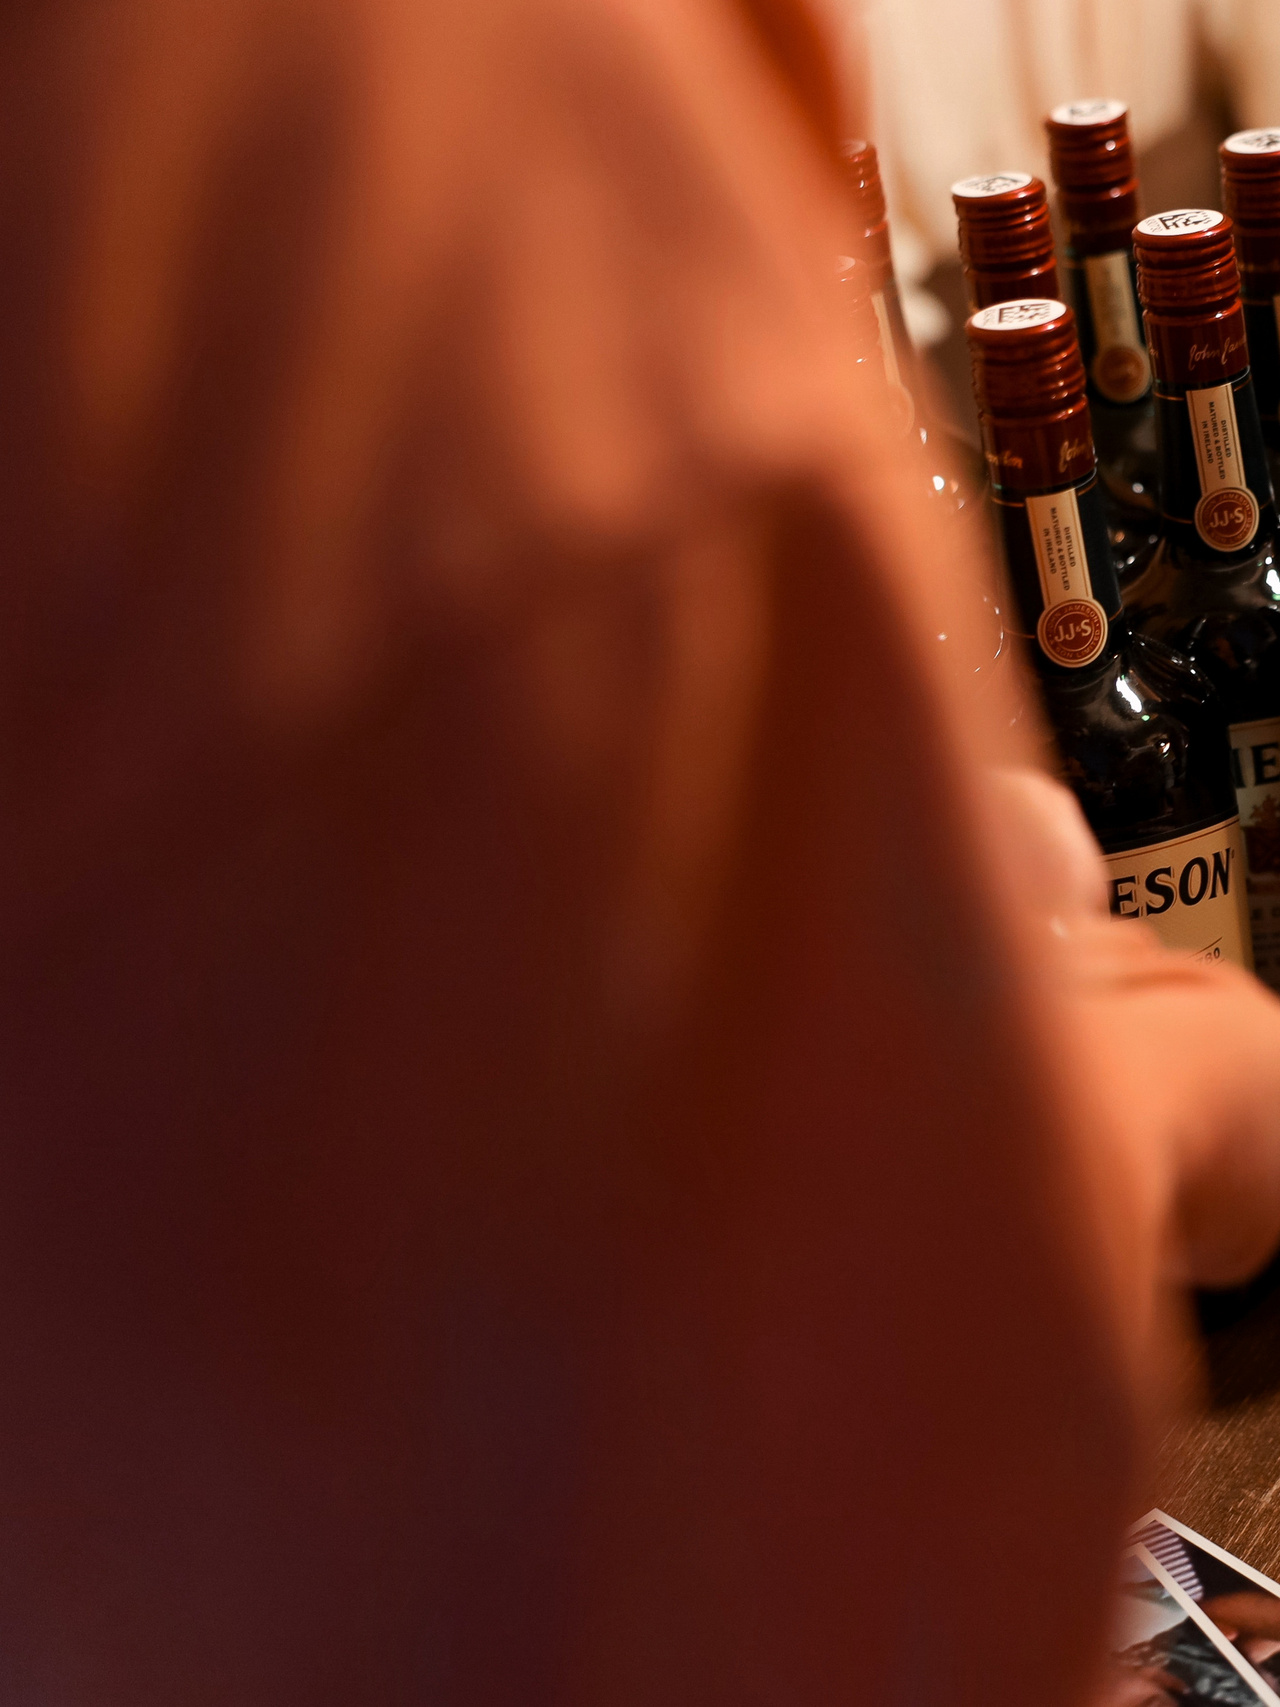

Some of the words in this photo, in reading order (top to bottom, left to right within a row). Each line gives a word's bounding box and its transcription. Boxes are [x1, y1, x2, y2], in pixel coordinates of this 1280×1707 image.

[1203, 430, 1214, 464] IRELAND
[1209, 401, 1220, 439] MATURED
[1216, 445, 1225, 480] BOTTLED
[1221, 419, 1231, 458] DISTILLED
[1044, 538, 1057, 575] IRELAND
[1050, 507, 1062, 547] MATURED
[1058, 554, 1070, 591] BOTTLED
[1064, 526, 1076, 567] DISTILLED
